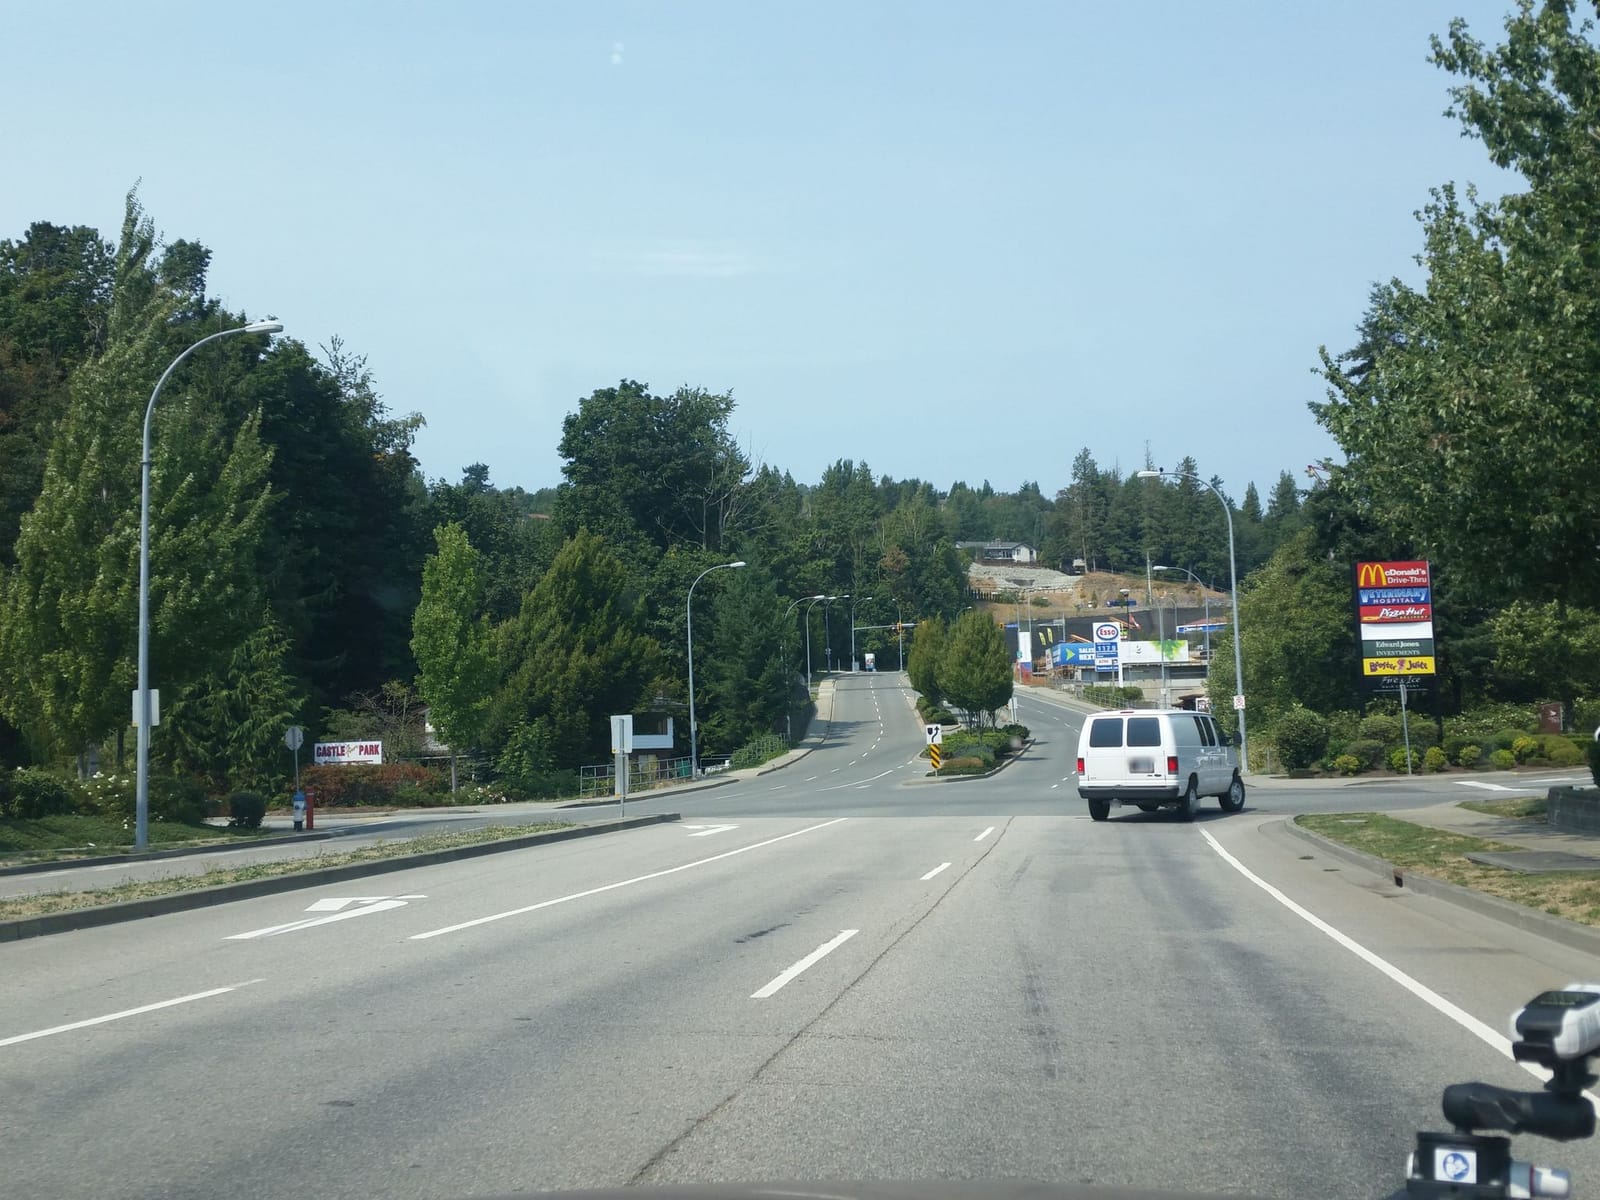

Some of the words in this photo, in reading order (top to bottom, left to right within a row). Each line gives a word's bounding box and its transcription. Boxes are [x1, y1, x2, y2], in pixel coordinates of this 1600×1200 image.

[1387, 576, 1427, 584] Drive-Thru
[1380, 608, 1405, 618] Pizza
[1405, 607, 1426, 616] Hut
[1406, 660, 1428, 671] Juice
[316, 746, 345, 757] CASTLE
[359, 745, 379, 755] PARK
